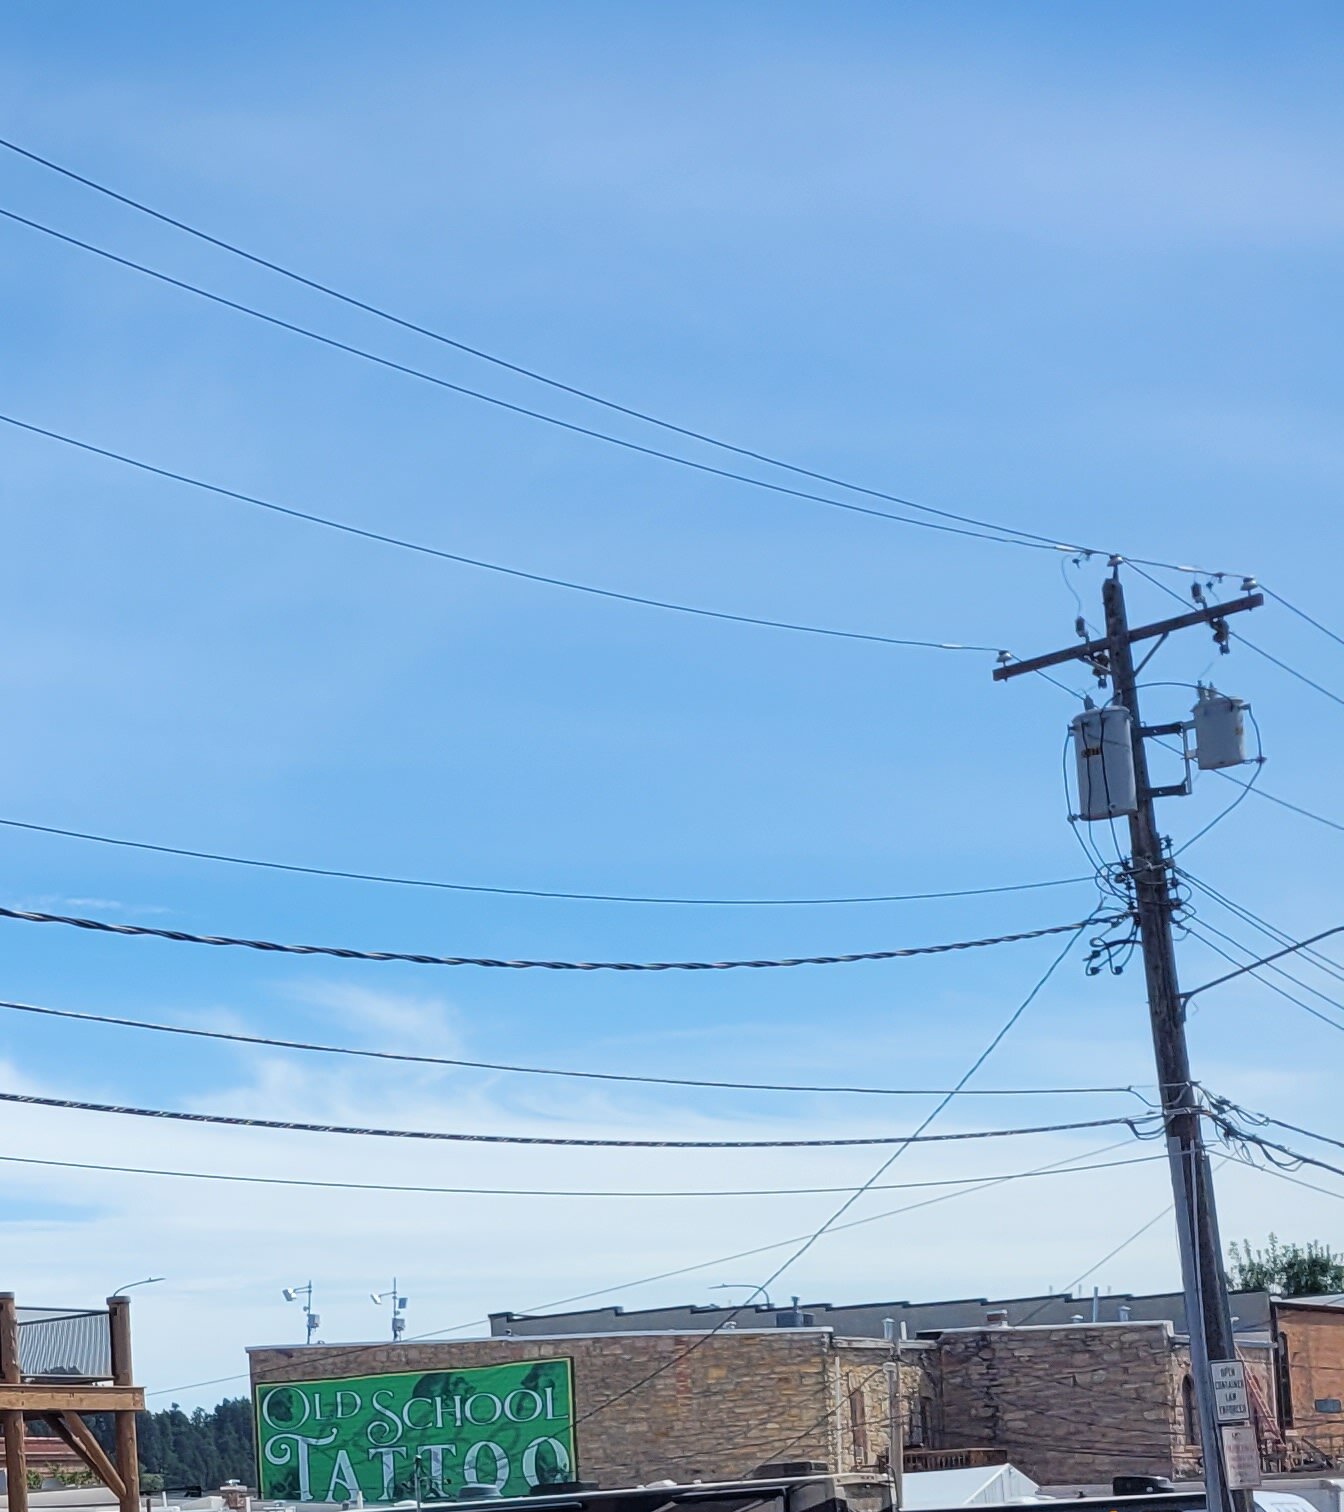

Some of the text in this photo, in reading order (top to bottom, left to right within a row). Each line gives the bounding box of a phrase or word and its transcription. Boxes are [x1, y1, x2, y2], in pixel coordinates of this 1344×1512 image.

[263, 1387, 569, 1446] OLD SCHOOL
[264, 1428, 570, 1501] TATTOO
